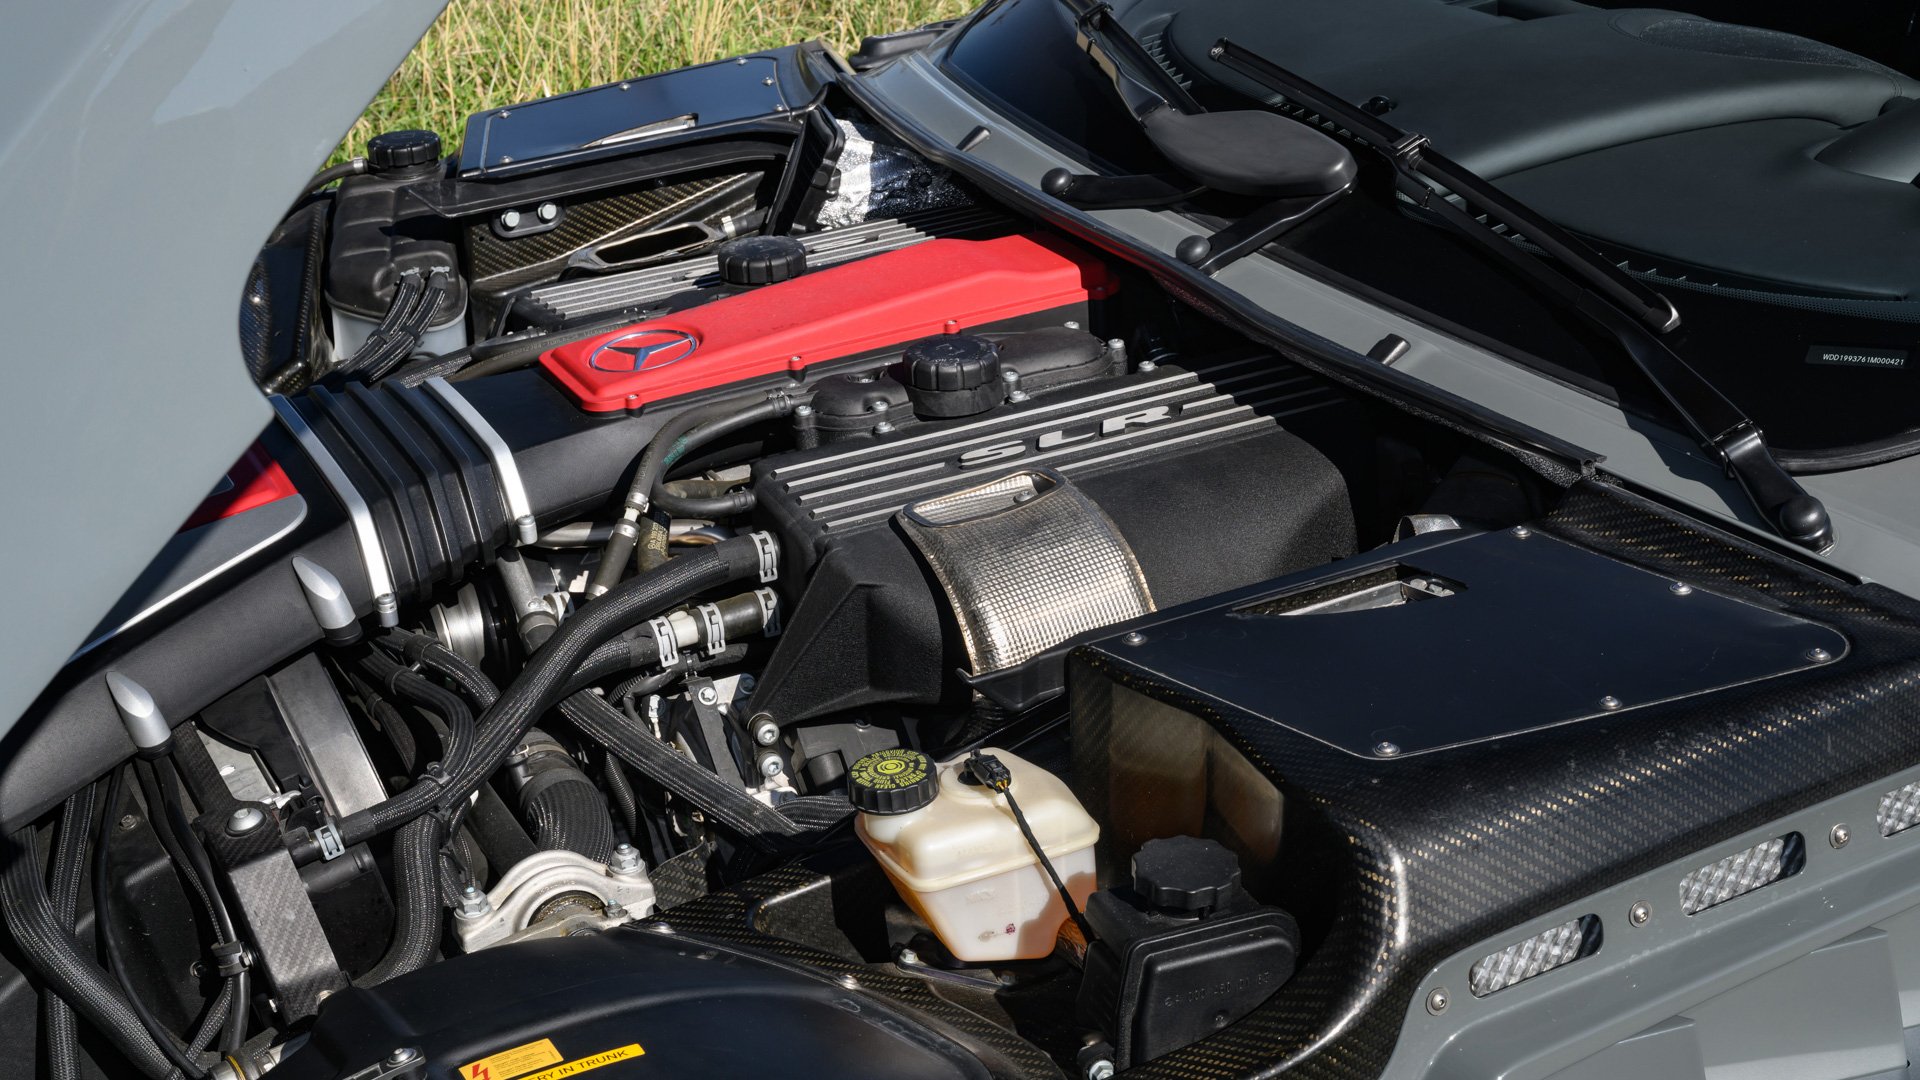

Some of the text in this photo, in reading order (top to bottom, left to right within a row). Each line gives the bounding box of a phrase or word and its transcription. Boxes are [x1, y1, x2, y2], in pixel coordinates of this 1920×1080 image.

[1822, 353, 1905, 366] WDD1993761M000421
[958, 405, 1173, 468] SLR
[559, 1065, 575, 1076] IN
[577, 1050, 629, 1069] TRUNK
